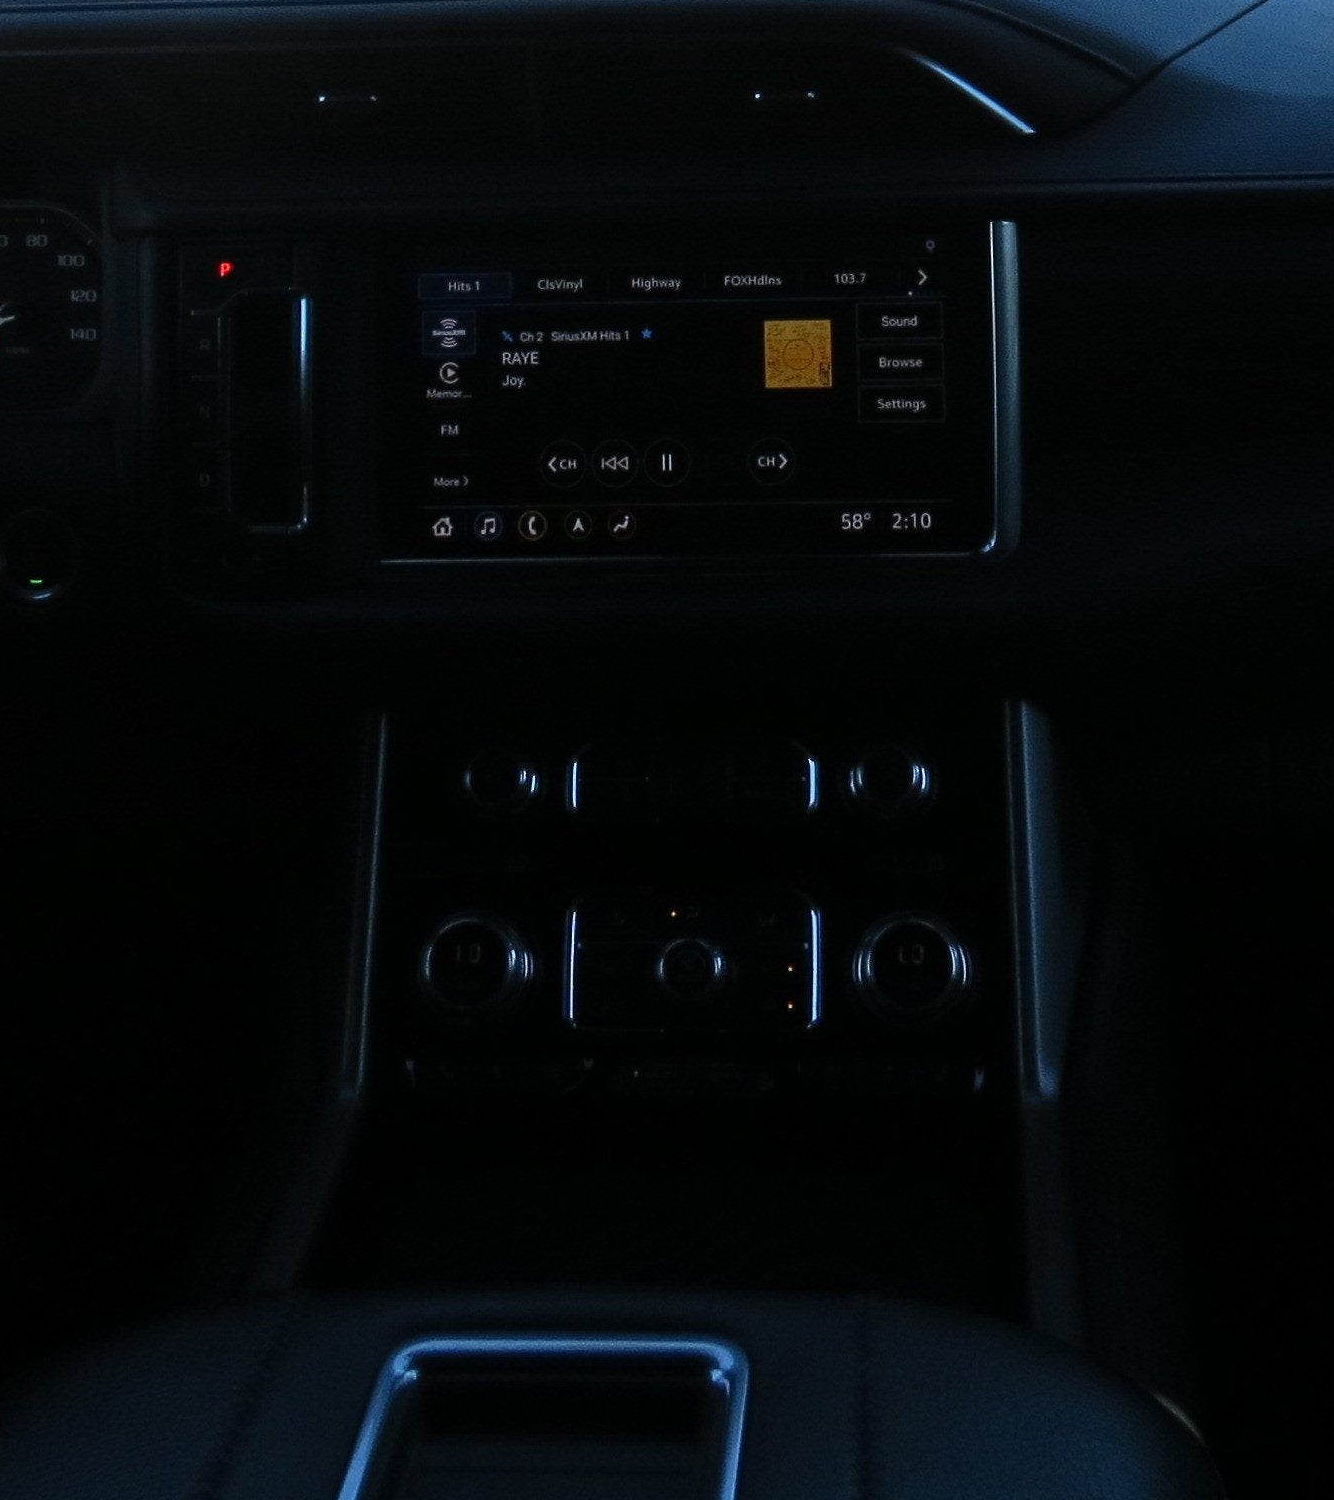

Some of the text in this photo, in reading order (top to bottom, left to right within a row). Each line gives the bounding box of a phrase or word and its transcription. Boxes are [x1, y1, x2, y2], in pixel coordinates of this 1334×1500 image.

[25, 233, 49, 248] 80
[57, 253, 86, 268] 100
[220, 262, 231, 277] P
[631, 277, 683, 292] Highway
[834, 272, 867, 285] 103.7
[447, 280, 481, 292] Hits 1
[70, 289, 98, 304] 120
[882, 316, 918, 328] Sound
[70, 327, 97, 342] 140
[520, 330, 630, 343] Ch 2 SiriusXM Hits 1
[502, 352, 540, 366] RAYE
[879, 357, 923, 368] Browse
[877, 399, 927, 413] Settings
[440, 424, 459, 436] FM
[559, 459, 577, 470] CH
[757, 456, 776, 468] CH
[433, 477, 461, 487] More
[841, 512, 932, 530] 58° 2:10
